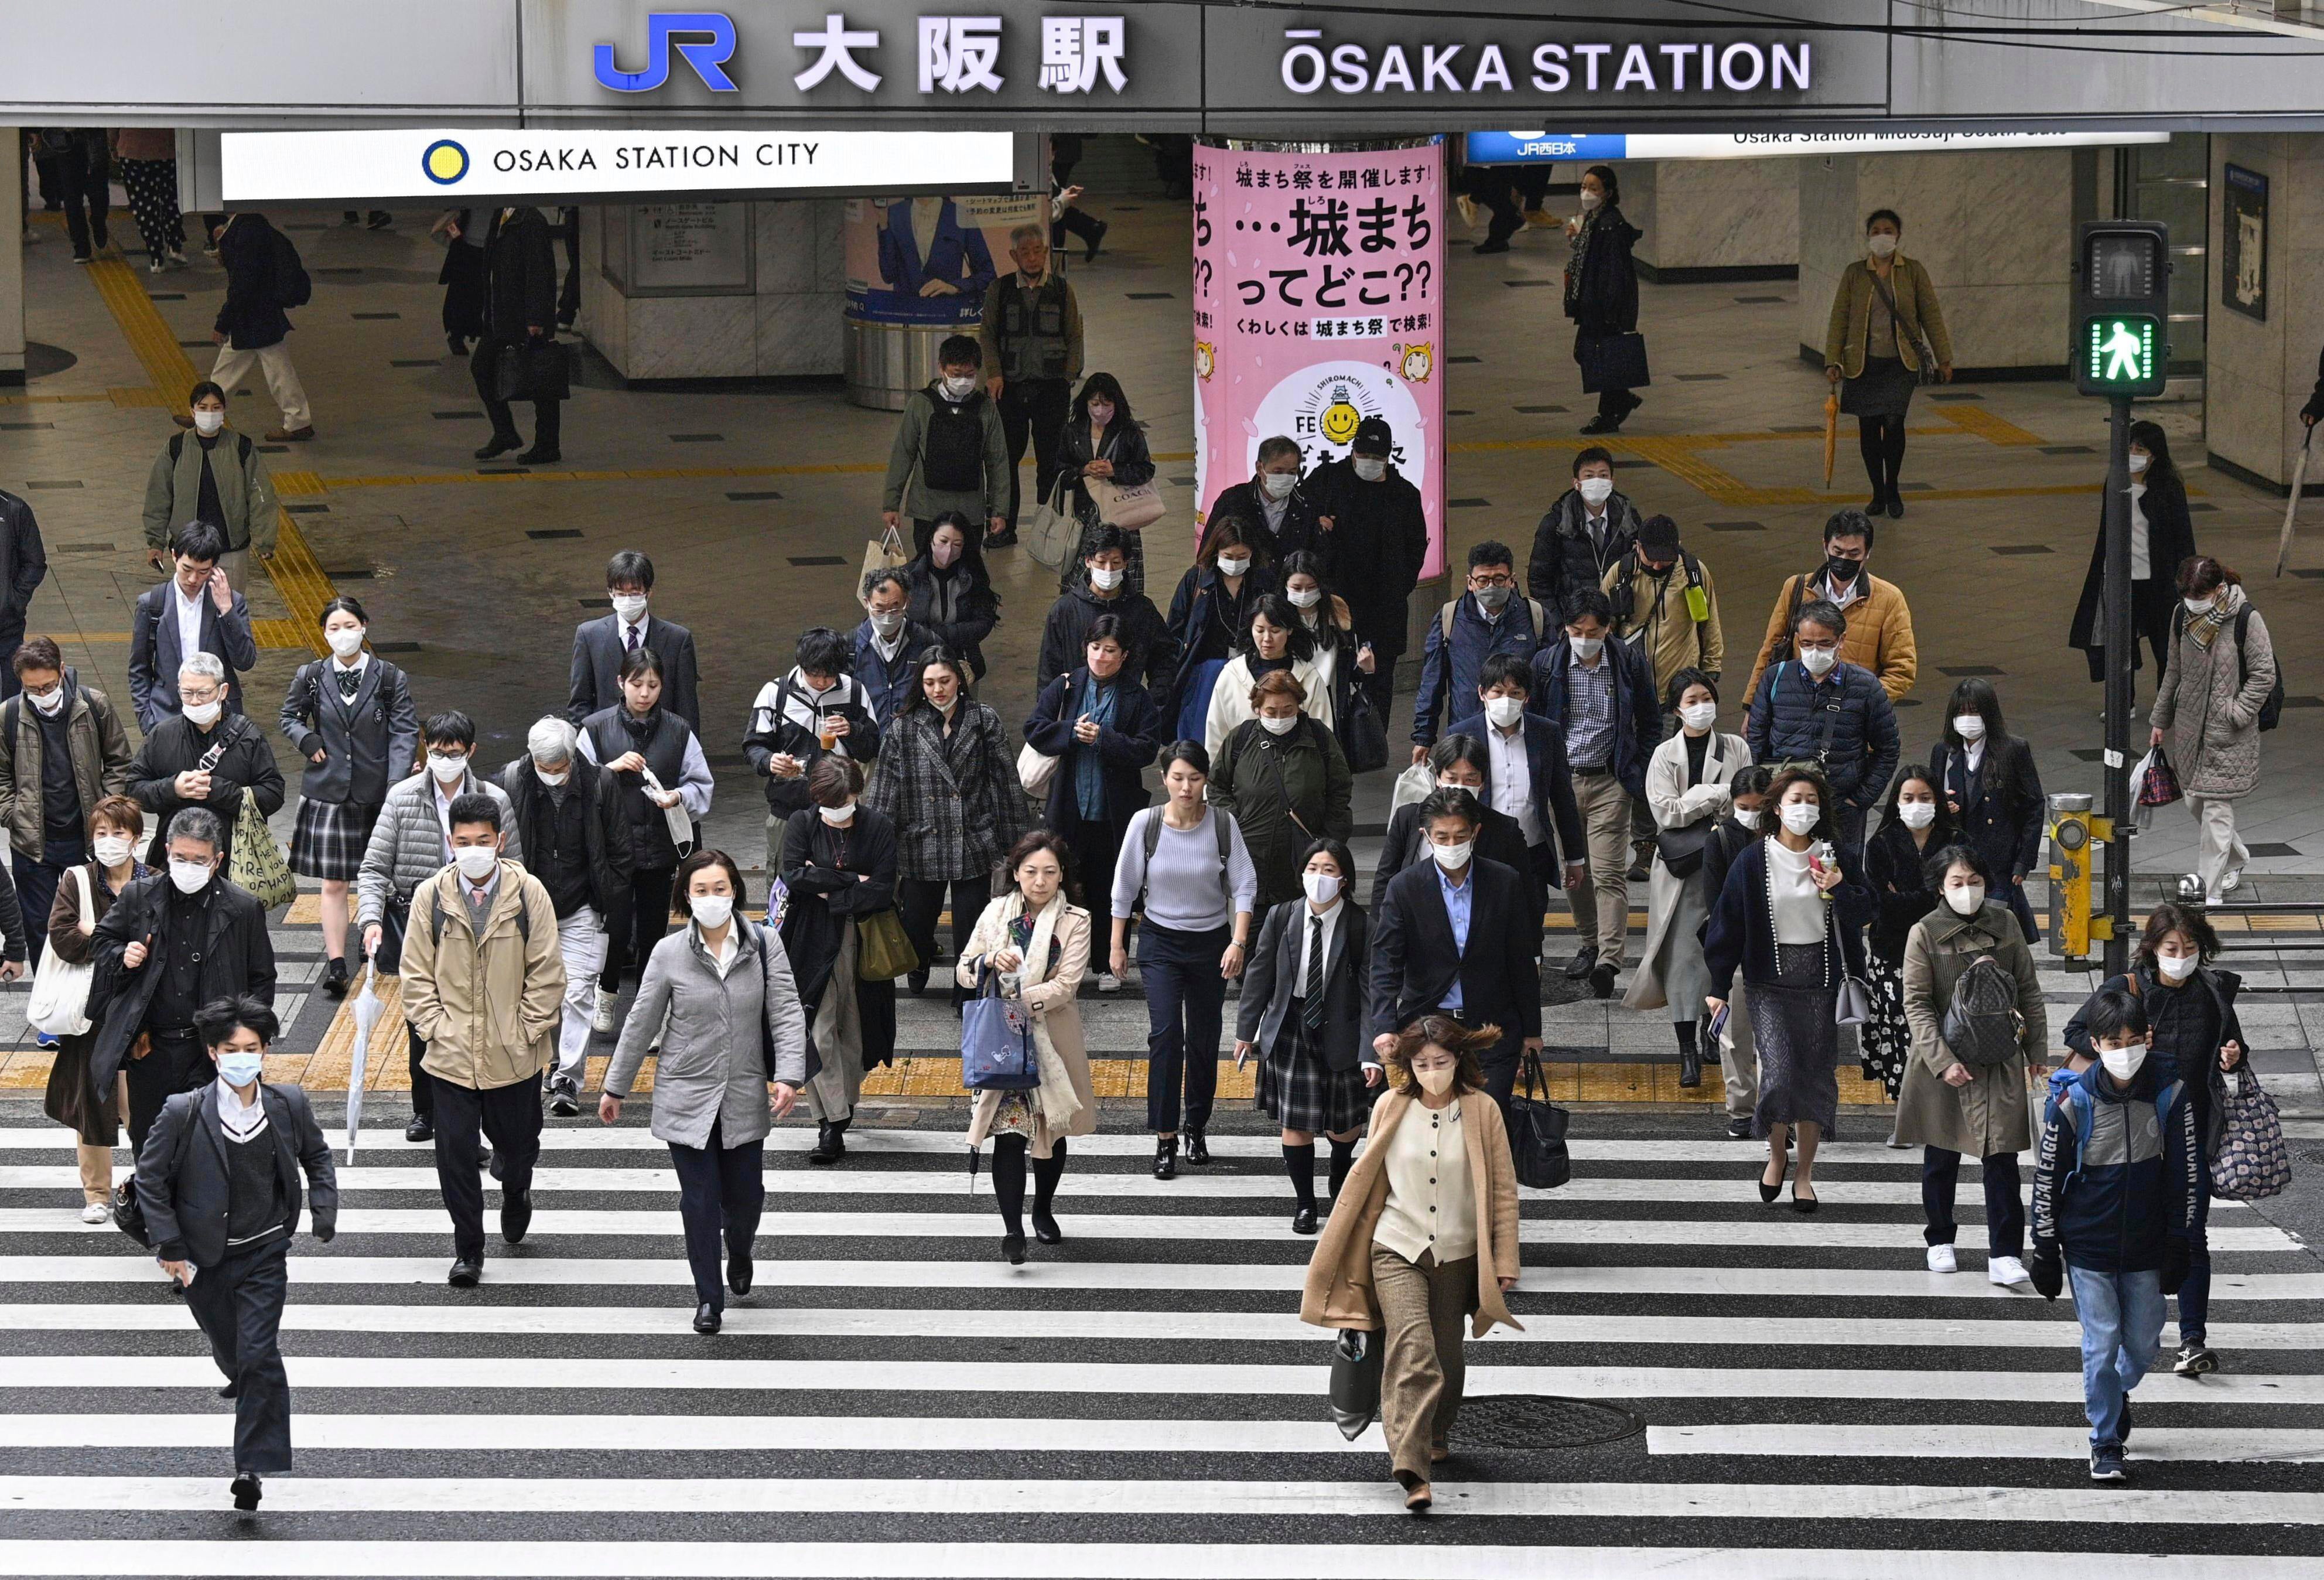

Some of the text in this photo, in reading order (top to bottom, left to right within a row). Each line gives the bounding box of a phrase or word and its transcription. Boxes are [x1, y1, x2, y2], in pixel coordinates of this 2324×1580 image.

[592, 12, 740, 93] JR
[792, 13, 1130, 94] 大阪駅
[1530, 42, 1812, 94] STATION
[494, 143, 819, 172] OSAKA STATION CITY
[1517, 141, 1576, 156] JR西日本
[1317, 374, 1364, 391] SHIROMACHI
[1113, 489, 1151, 503] COACH
[2038, 1121, 2059, 1171] EAGLE
